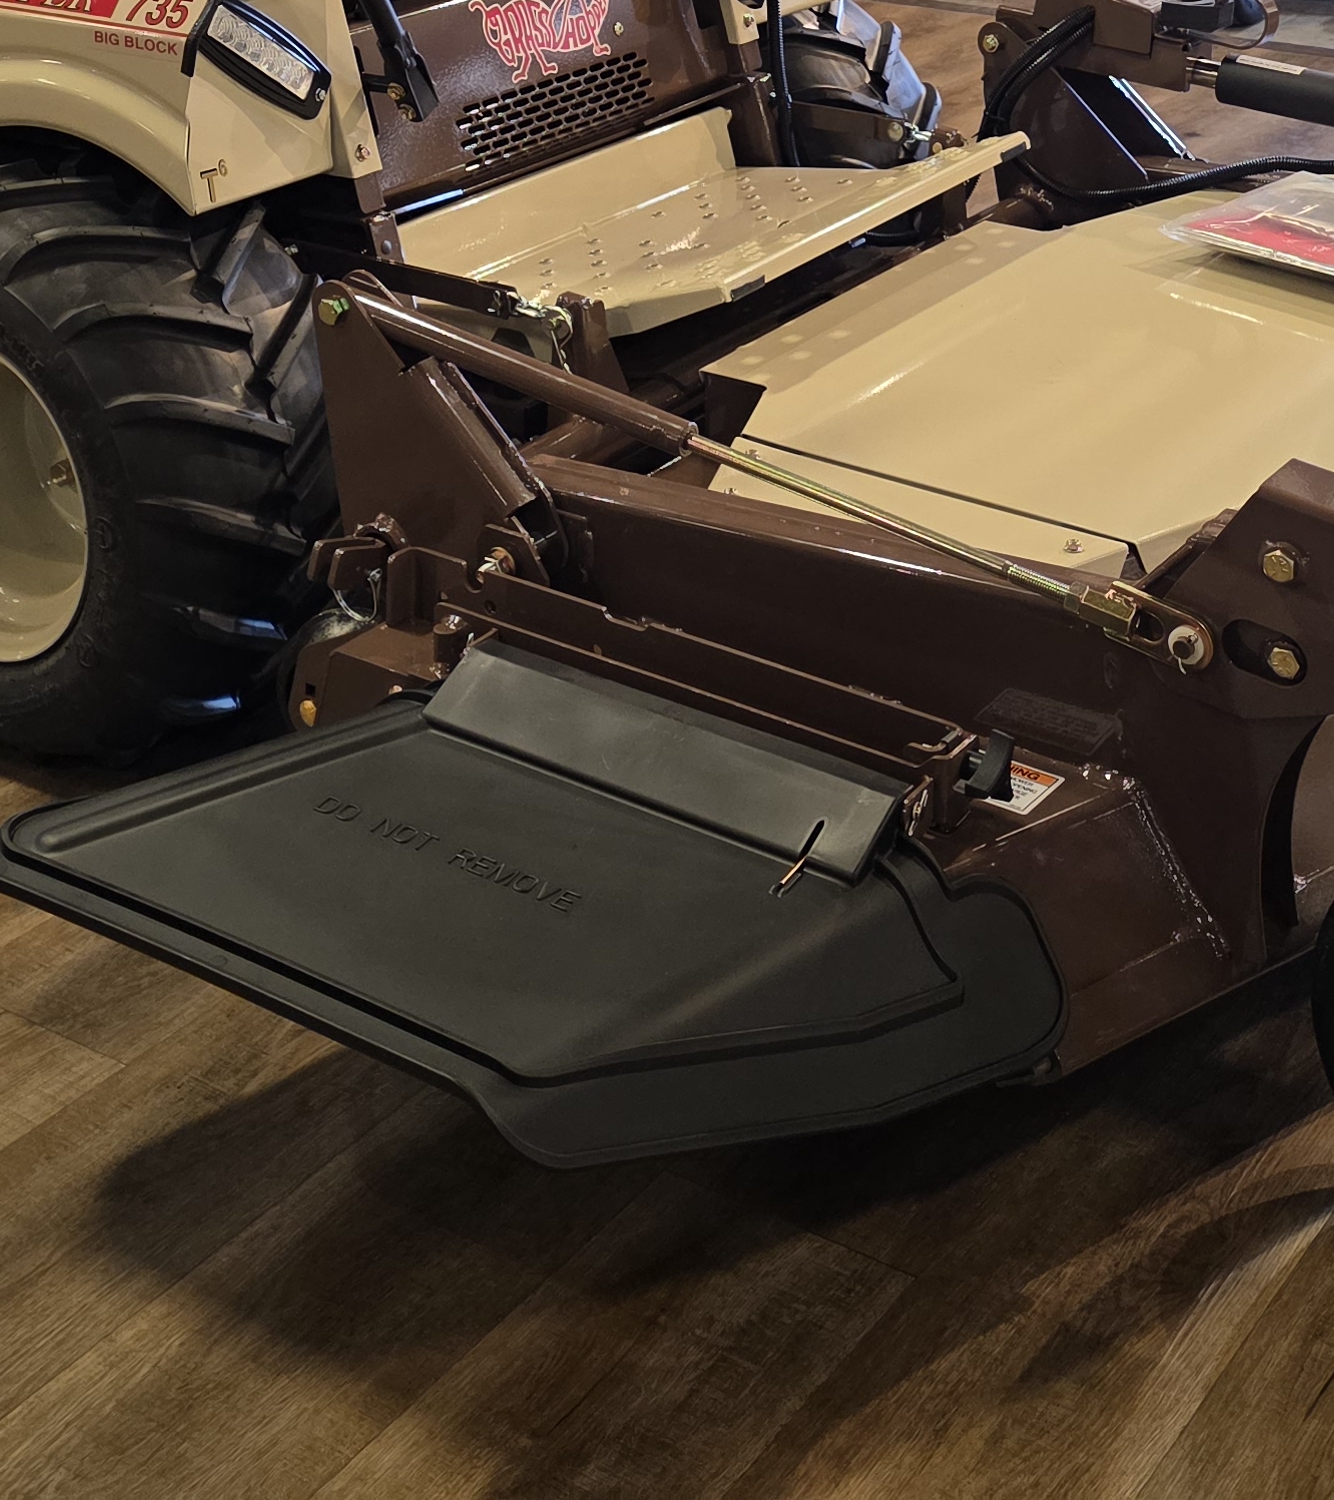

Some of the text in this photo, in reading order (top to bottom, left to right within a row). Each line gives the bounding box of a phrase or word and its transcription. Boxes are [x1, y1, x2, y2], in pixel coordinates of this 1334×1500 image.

[94, 30, 178, 56] BIG BLOCK
[312, 796, 583, 913] DO NOT REMOVE
